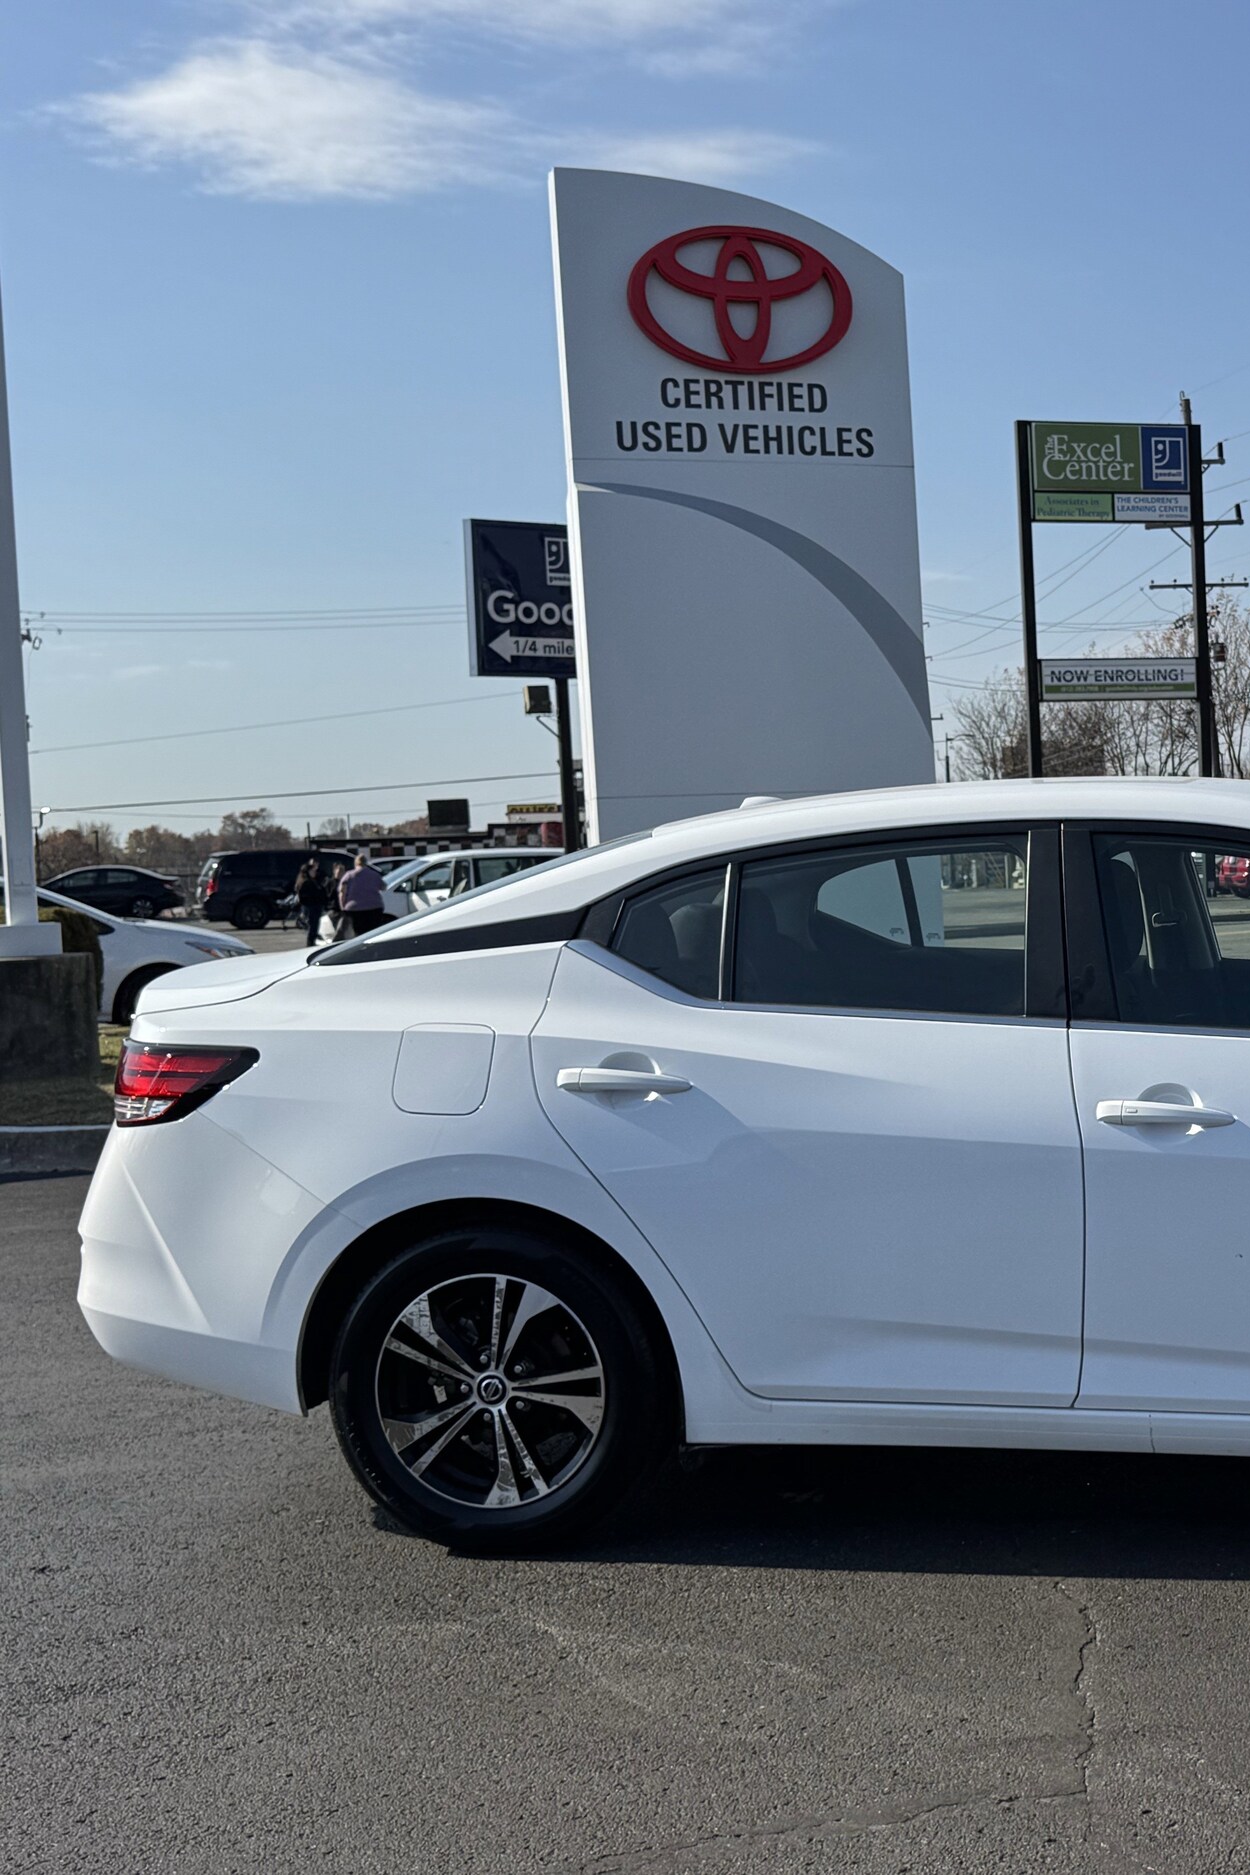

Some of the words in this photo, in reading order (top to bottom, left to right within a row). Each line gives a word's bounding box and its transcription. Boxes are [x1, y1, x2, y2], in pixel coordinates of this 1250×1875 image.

[659, 377, 829, 413] CERTIFIED
[615, 420, 708, 452] USED
[717, 422, 875, 458] VEHICLES
[1051, 434, 1124, 462] Excel
[1042, 453, 1135, 481] Center
[1116, 496, 1131, 504] THE
[1132, 496, 1179, 504] CHILDREN'S
[1117, 505, 1157, 513] LEARNING
[1158, 505, 1189, 513] CENTER
[513, 639, 538, 654] 1/4
[1050, 669, 1090, 683] NOW
[1094, 668, 1185, 683] ENROLLING!
